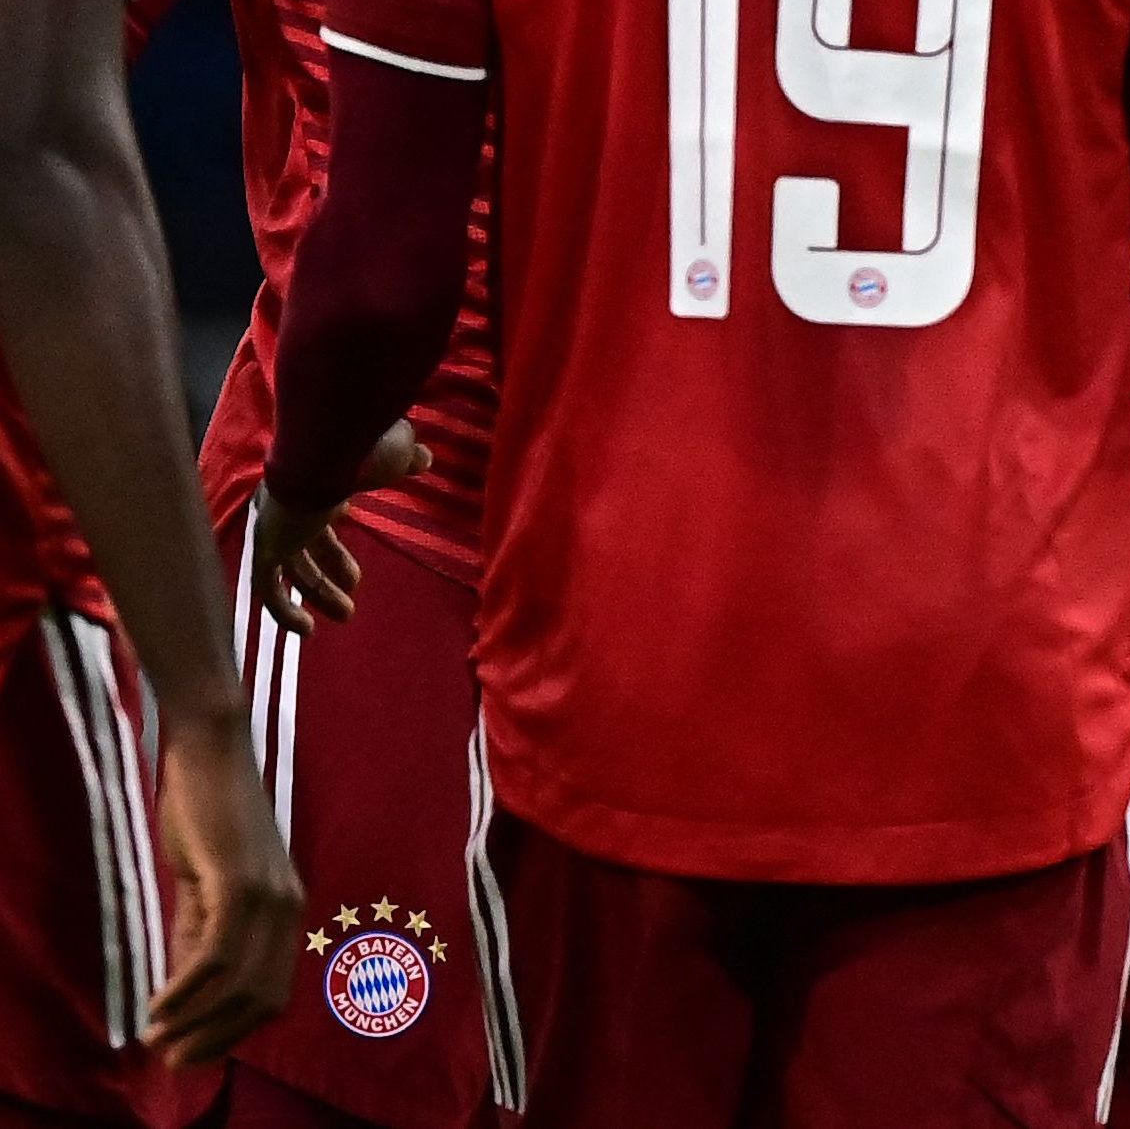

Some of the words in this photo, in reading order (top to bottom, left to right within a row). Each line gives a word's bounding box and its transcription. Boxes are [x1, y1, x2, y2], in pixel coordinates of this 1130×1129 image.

[335, 951, 356, 975] FC
[357, 938, 422, 981] BAYERN
[333, 992, 419, 1032] MÜNCHEN
